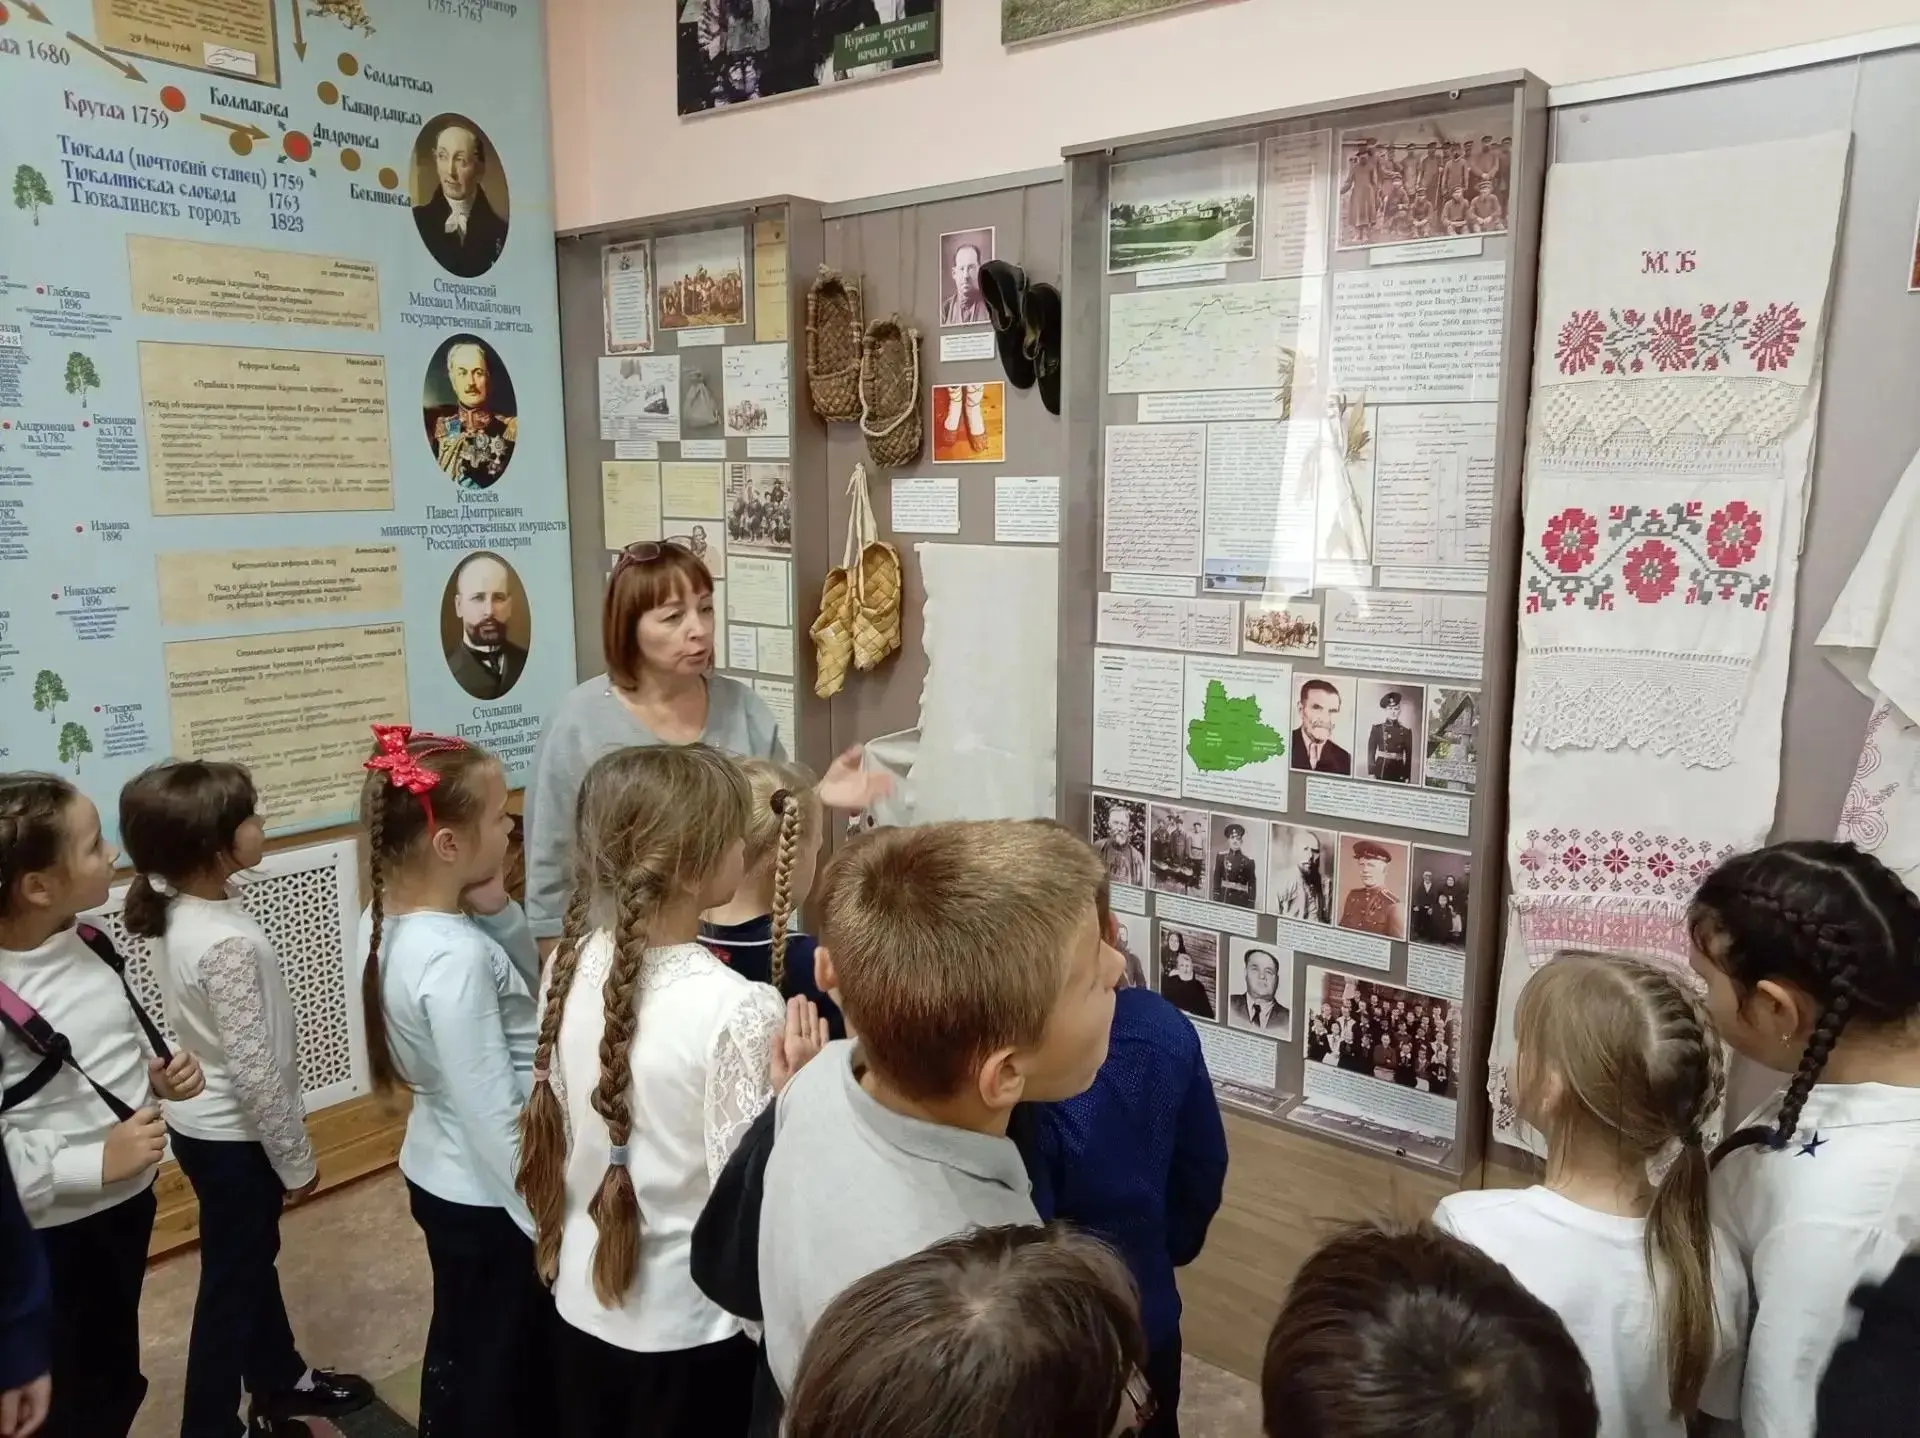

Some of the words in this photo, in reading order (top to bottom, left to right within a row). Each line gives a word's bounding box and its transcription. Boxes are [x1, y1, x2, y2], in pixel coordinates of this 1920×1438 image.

[28, 40, 70, 66] 1680
[64, 88, 125, 121] Крутая
[132, 105, 169, 129] 1759
[209, 86, 289, 118] Колмакова
[57, 134, 124, 164] Тюкала
[273, 171, 304, 190] 1759
[61, 159, 174, 195] Тюкалинская
[179, 182, 236, 204] слобода
[269, 192, 300, 212] 1763
[67, 181, 180, 218] Тюкалинскъ
[188, 203, 241, 226] городъ
[270, 212, 304, 233] 1823
[433, 277, 497, 298] Сперанский
[409, 291, 453, 309] Михаил
[456, 297, 521, 315] Михайлович
[400, 311, 491, 330] государственный
[494, 318, 533, 333] деятель
[426, 506, 458, 520] Павел
[461, 505, 523, 521] Дмитриевич
[381, 524, 428, 538] министр
[430, 522, 516, 537] государственных
[519, 519, 567, 534] имуществ
[426, 536, 486, 551] Российской
[488, 536, 532, 550] империи
[472, 704, 522, 719] Столыпин
